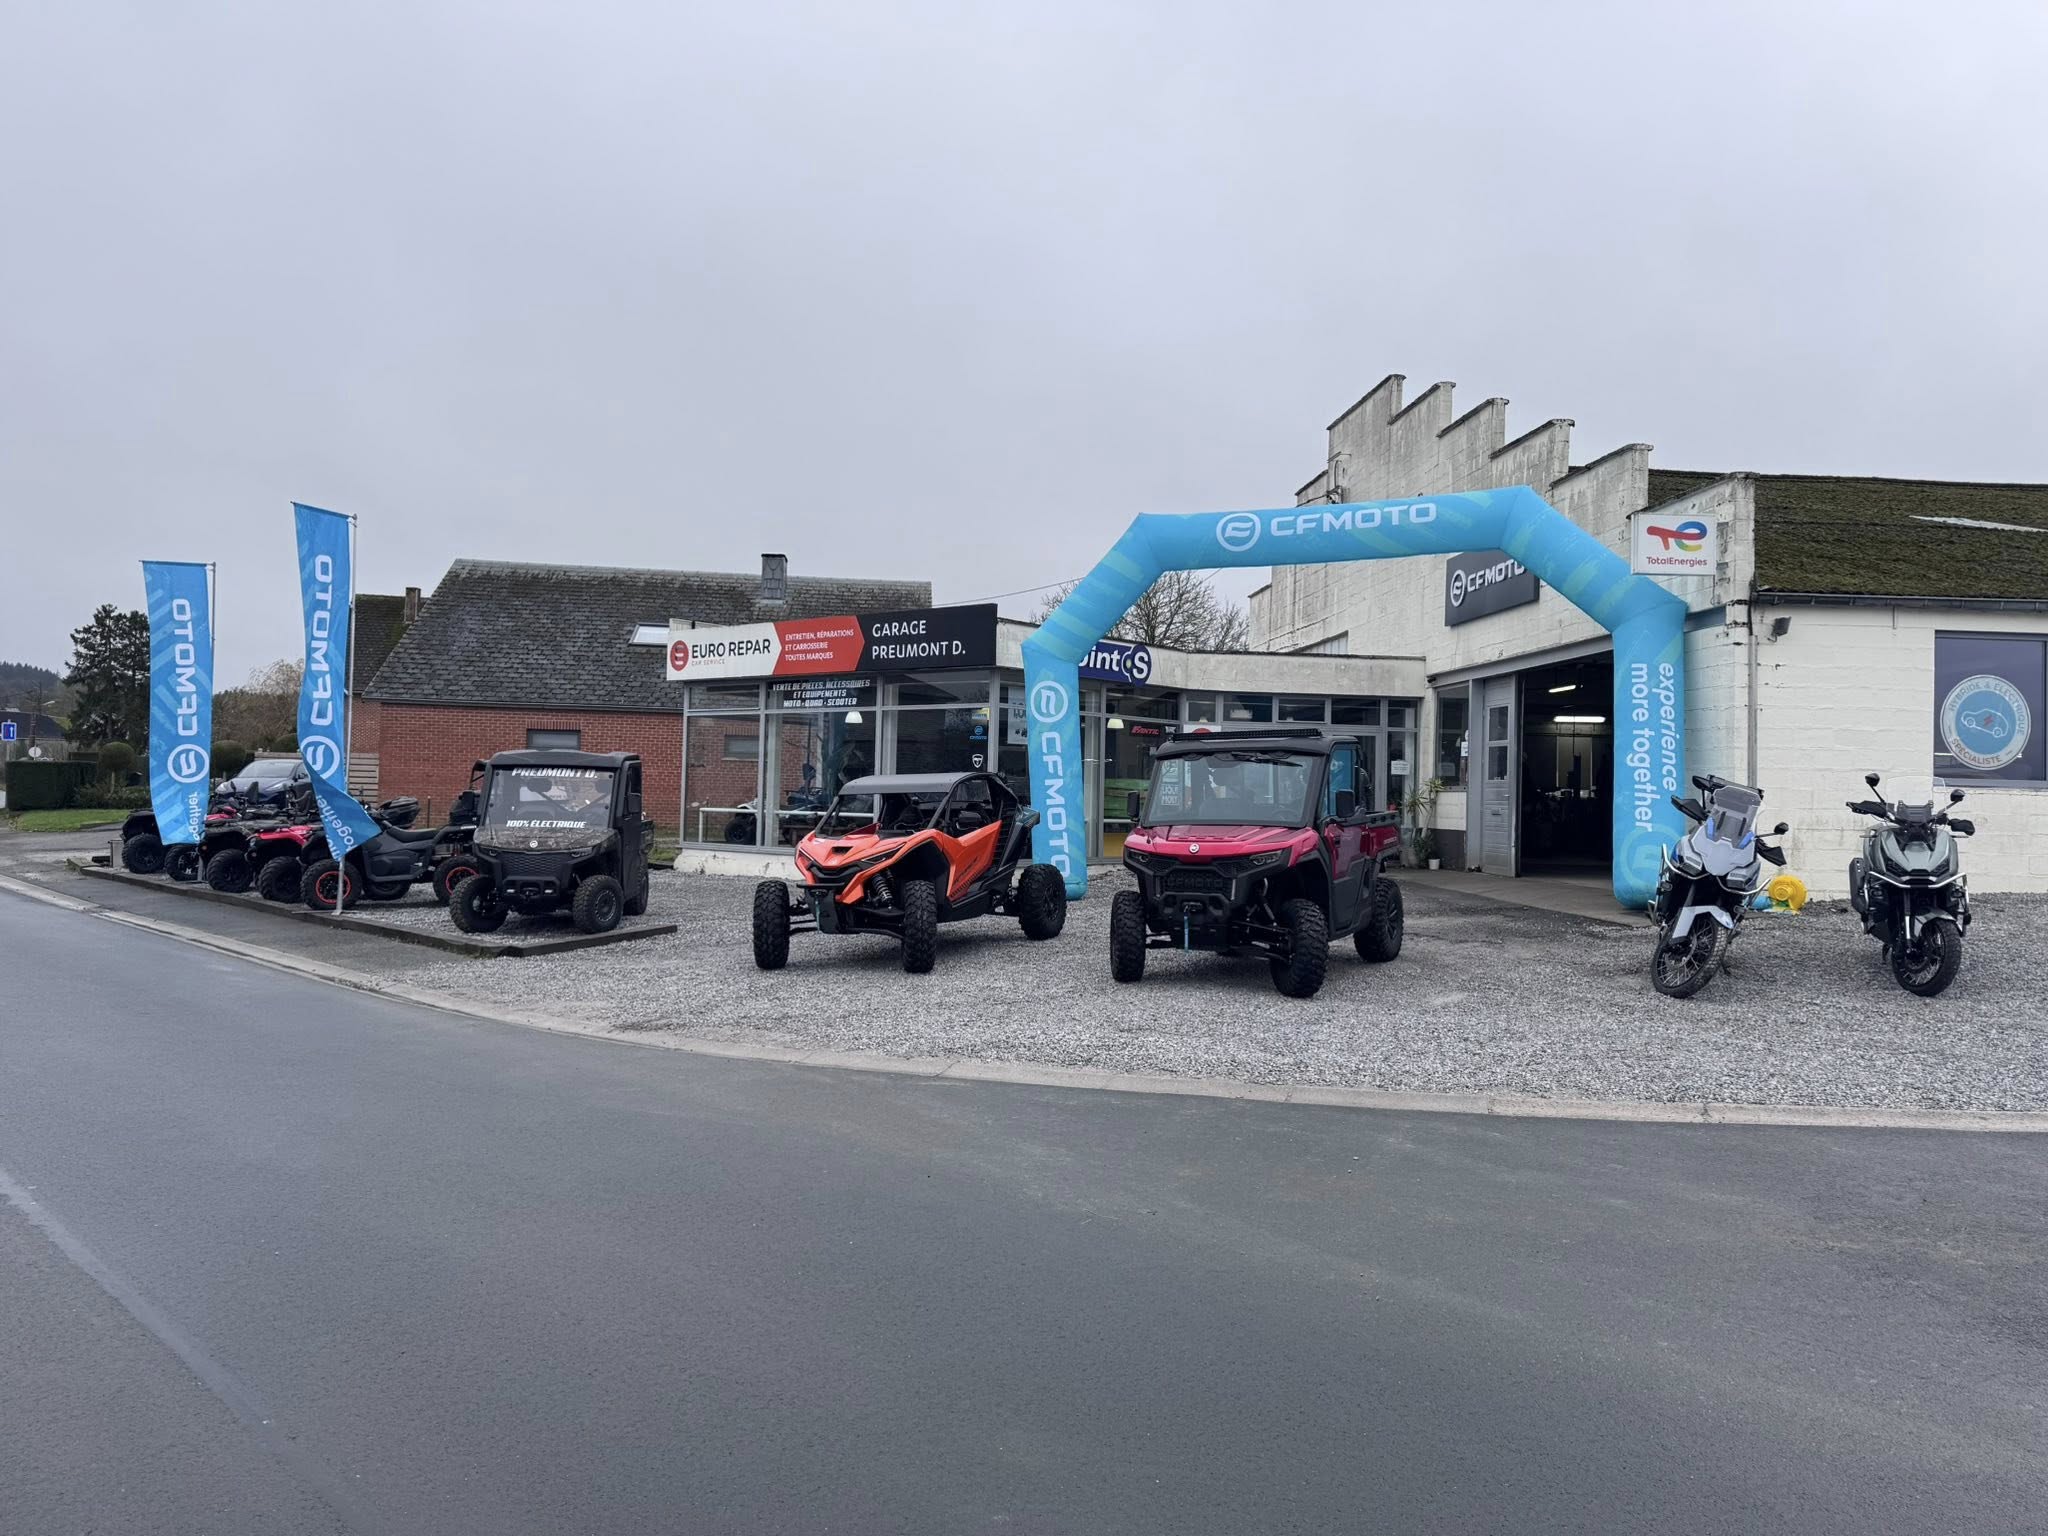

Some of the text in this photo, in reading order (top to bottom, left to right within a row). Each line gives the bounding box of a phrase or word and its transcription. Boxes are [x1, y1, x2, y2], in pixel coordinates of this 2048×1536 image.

[1270, 503, 1437, 536] CFMOTO
[1646, 556, 1708, 568] TotalEnergies
[785, 628, 854, 641] ENTRETIEN, RÉPARATIONS
[872, 620, 927, 637] GARAGE
[692, 639, 771, 659] EURO REPAR
[785, 641, 829, 651] ET CARROSSERIE
[872, 641, 966, 660] PREUMONT D.
[703, 658, 725, 666] SERVICE
[784, 652, 834, 661] TOUTES MARQUES
[1132, 651, 1149, 679] S
[792, 683, 801, 691] DE
[783, 697, 857, 707] MOTO QUAD SCOOTER
[1948, 682, 1980, 711] HYBRIDE
[1652, 662, 1679, 791] experience
[1626, 663, 1660, 832] more together
[1041, 731, 1071, 878] CFMOTO
[506, 819, 587, 829] 100% ÉLECTRIQUE
